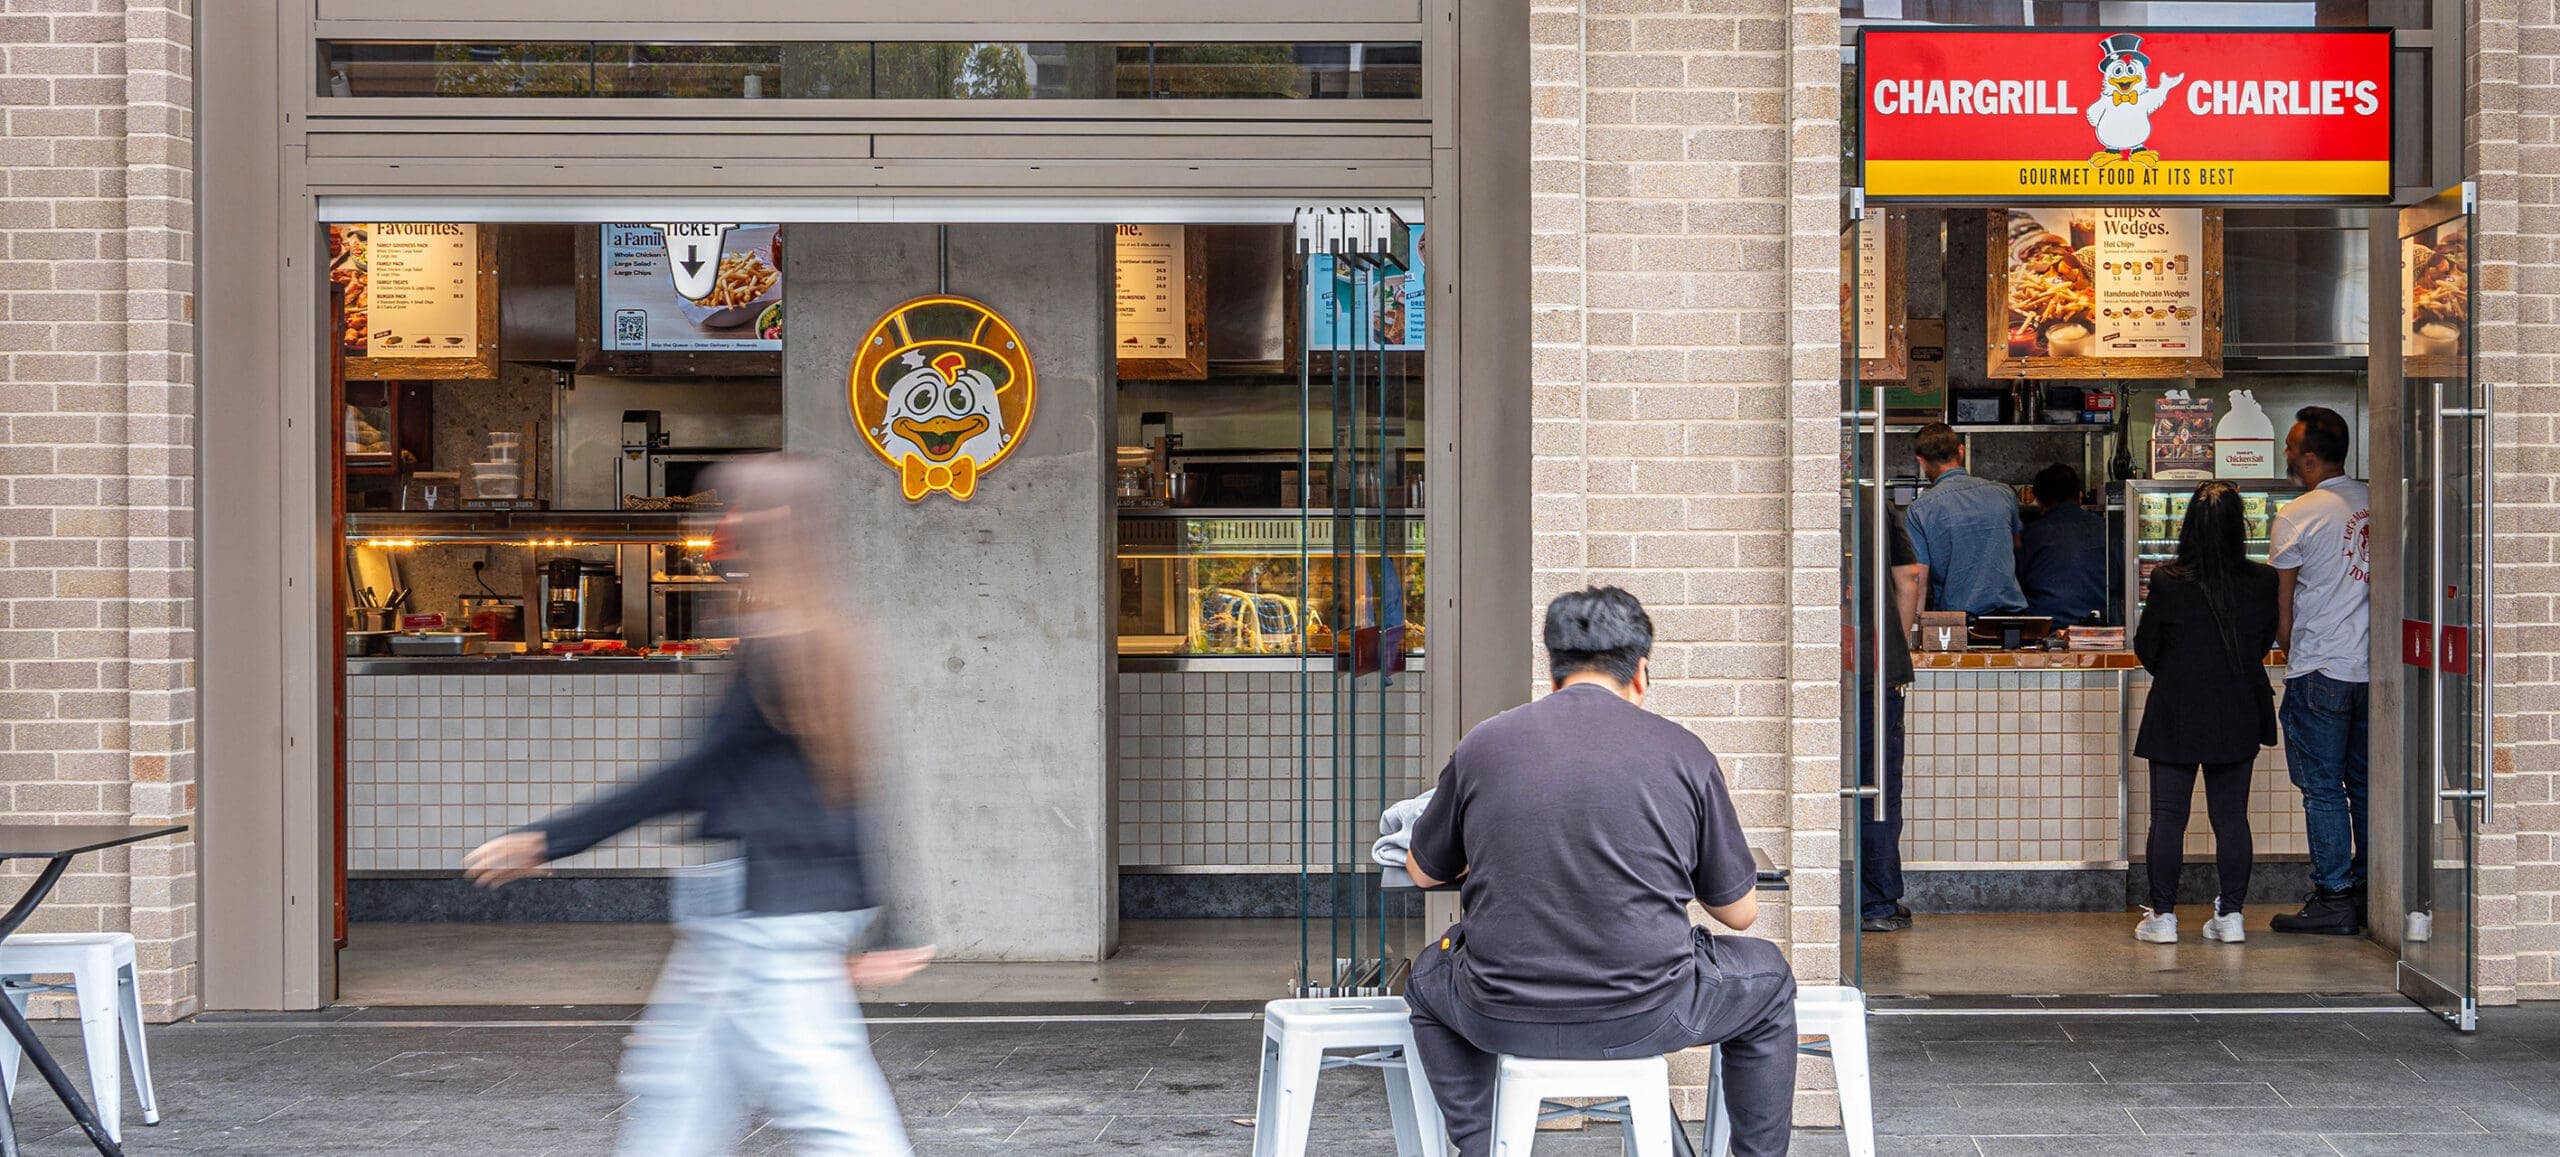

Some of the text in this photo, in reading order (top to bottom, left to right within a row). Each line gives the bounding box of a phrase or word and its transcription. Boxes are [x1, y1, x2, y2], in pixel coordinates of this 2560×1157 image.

[1873, 78, 2379, 116] CHARGRILL CHARLIE'S
[2019, 168, 2236, 186] GOURMET FOOD AT ITS BEST
[377, 223, 464, 235] Favourites.
[666, 223, 721, 237] TICKET
[2104, 221, 2169, 239] Wedges.
[614, 236, 622, 246] a
[2141, 290, 2162, 298] Potato
[2163, 290, 2190, 298] Wedges
[2344, 520, 2356, 540] Let's
